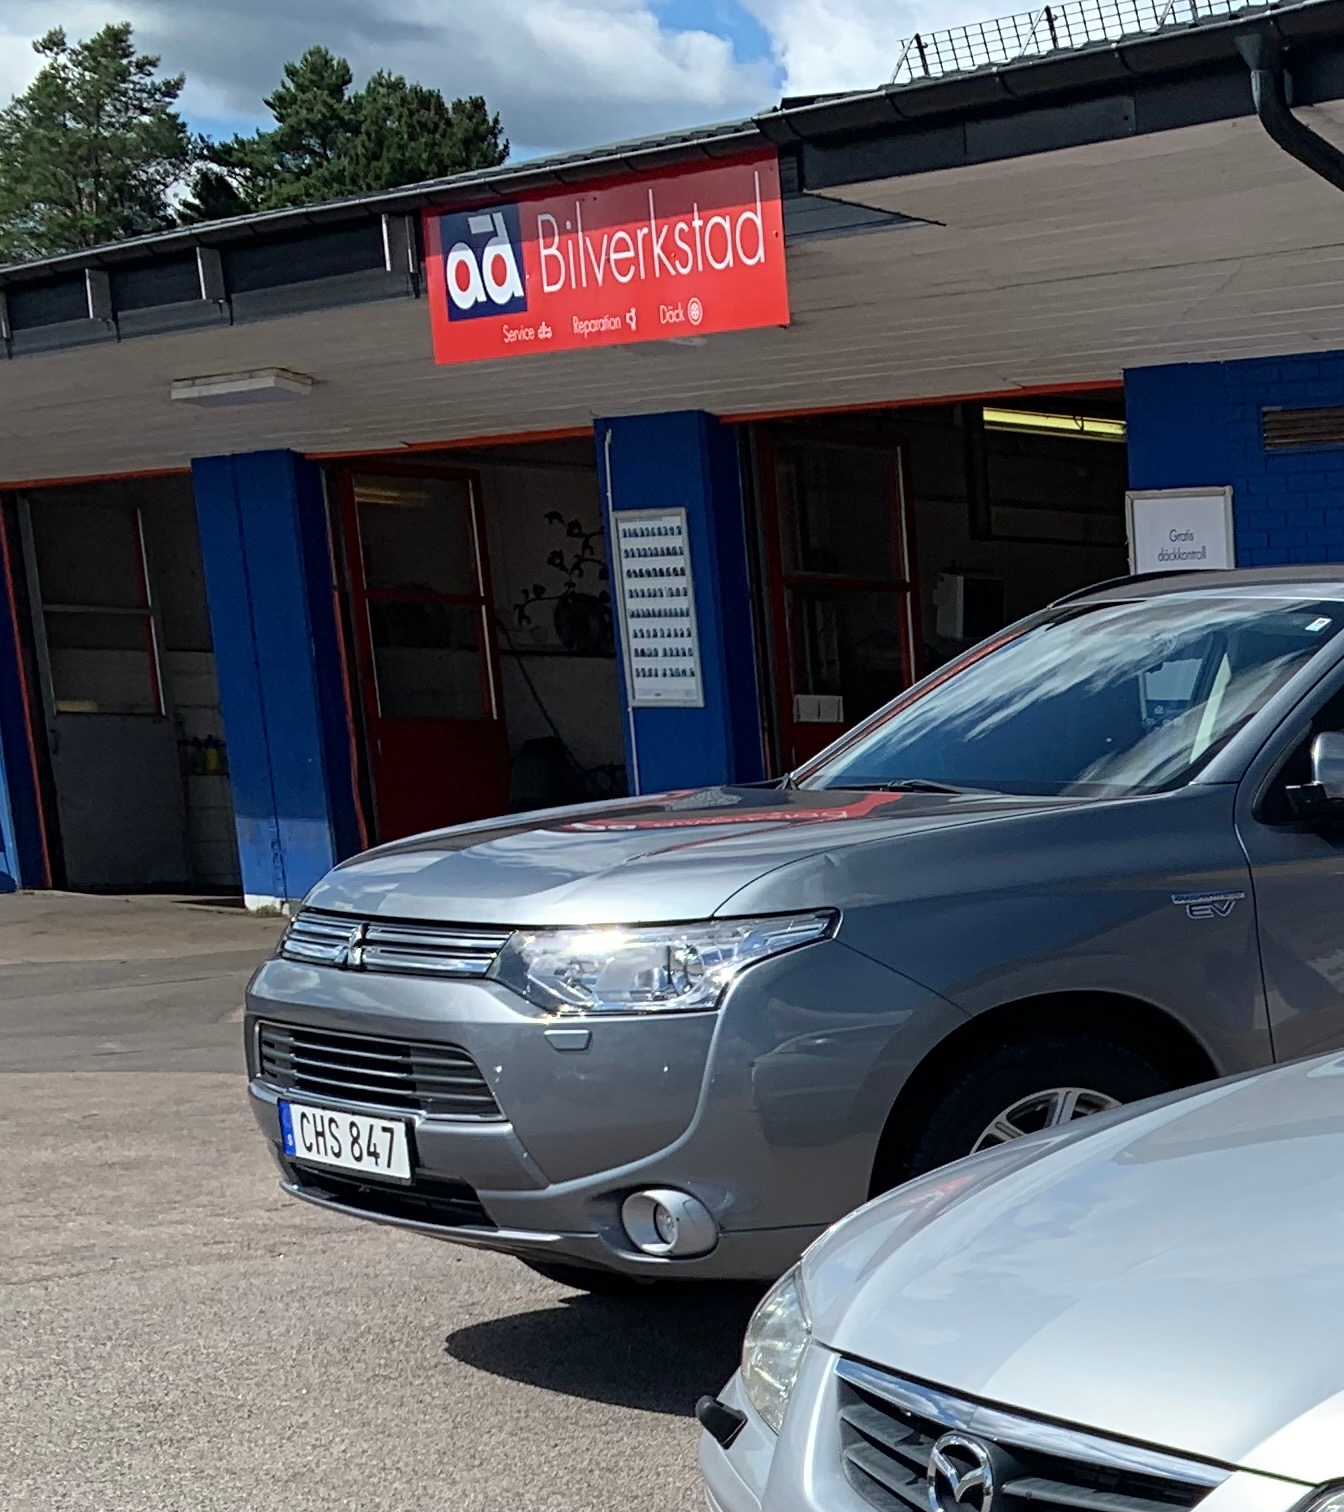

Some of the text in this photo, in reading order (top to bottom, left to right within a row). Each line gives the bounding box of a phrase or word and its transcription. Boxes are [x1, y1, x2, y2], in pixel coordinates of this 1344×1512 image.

[536, 170, 767, 294] Bilverkstad
[502, 304, 685, 344] Service Reparation Däck
[1168, 528, 1195, 543] Gratis
[1157, 545, 1207, 562] däckkontroll
[1186, 900, 1236, 919] EV
[300, 1111, 394, 1169] CHS 847
